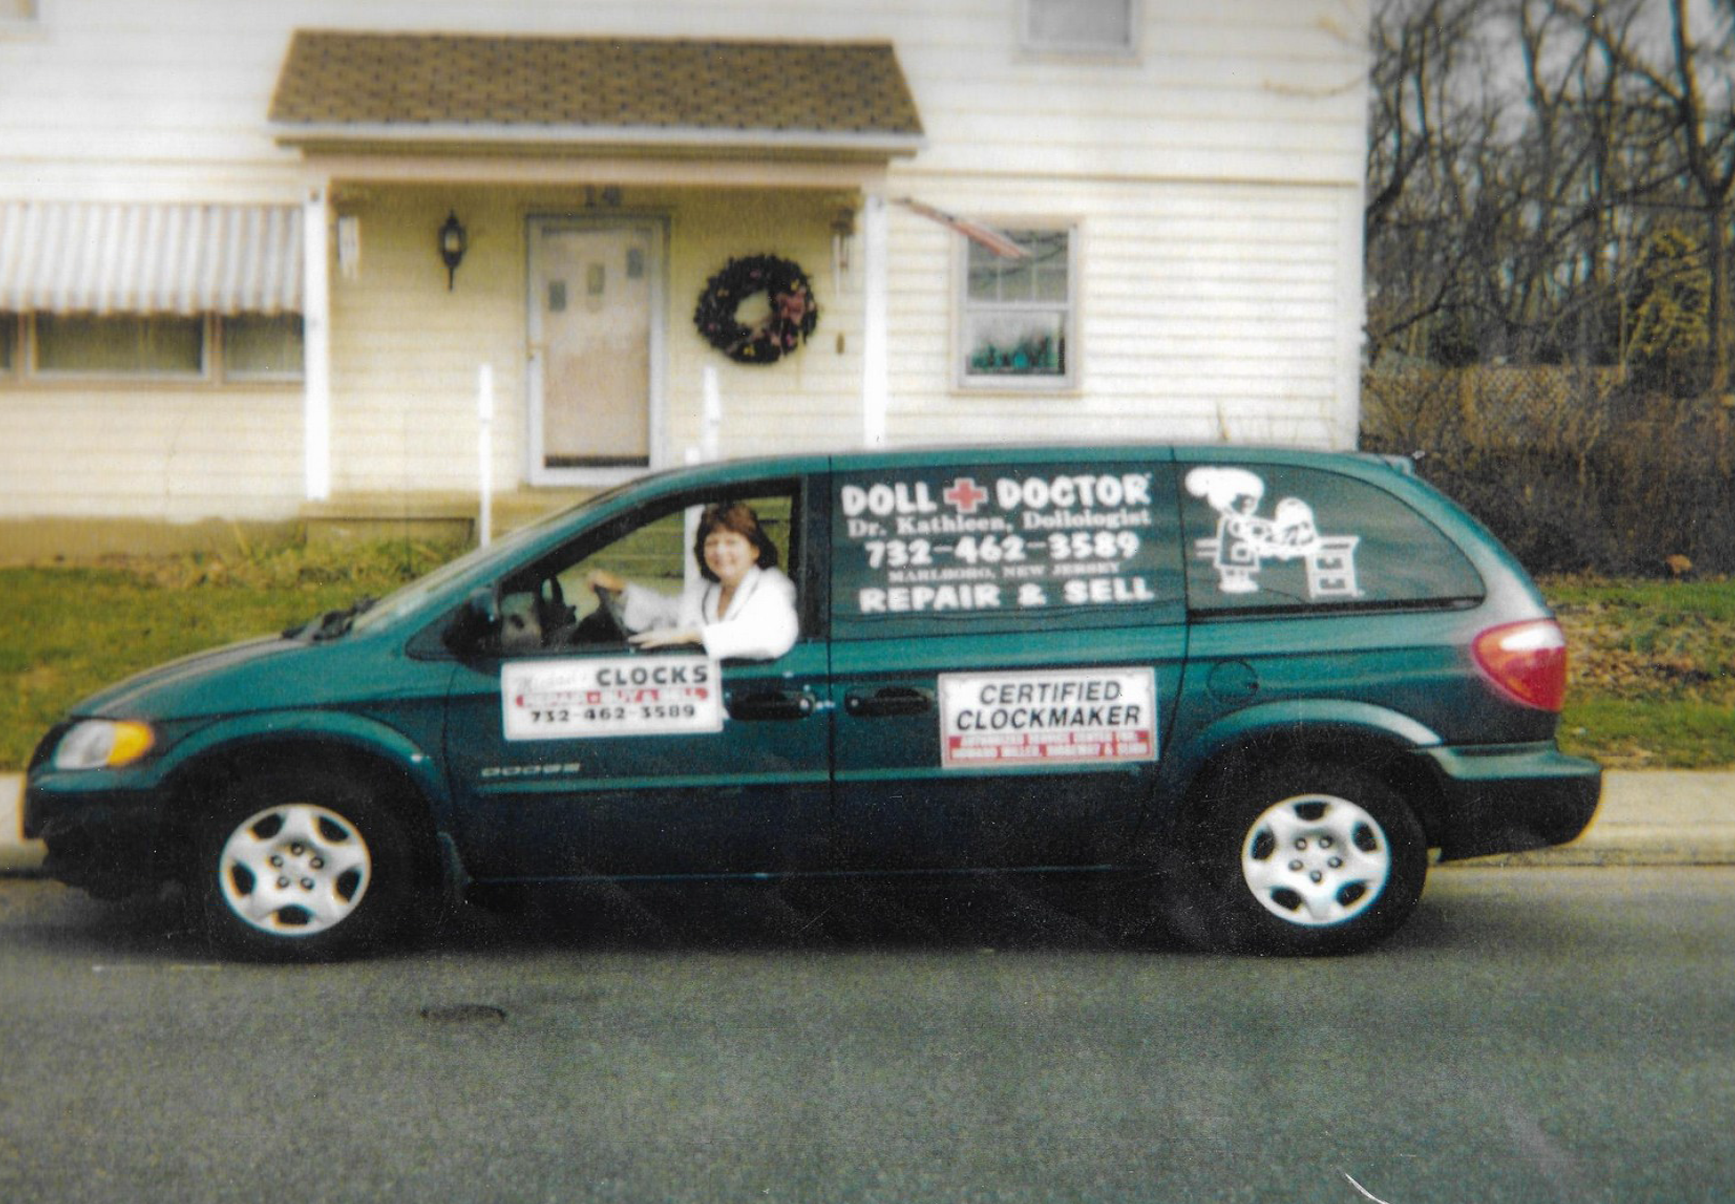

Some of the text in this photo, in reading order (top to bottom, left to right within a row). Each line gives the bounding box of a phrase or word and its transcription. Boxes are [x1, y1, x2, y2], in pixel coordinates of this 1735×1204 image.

[841, 473, 1151, 516] DOLL DOCTOR
[848, 519, 887, 538] Dr.
[897, 512, 1013, 536] Kathleen,
[864, 531, 1140, 569] 732-462-3589
[1002, 564, 1046, 579] NEW
[859, 576, 1155, 614] REPAIR & SELL
[596, 665, 708, 687] CLOCKS
[979, 681, 1121, 706] CERTIFIED
[531, 704, 695, 723] 732-462-3589
[956, 705, 1141, 731] CLOCKMAKER
